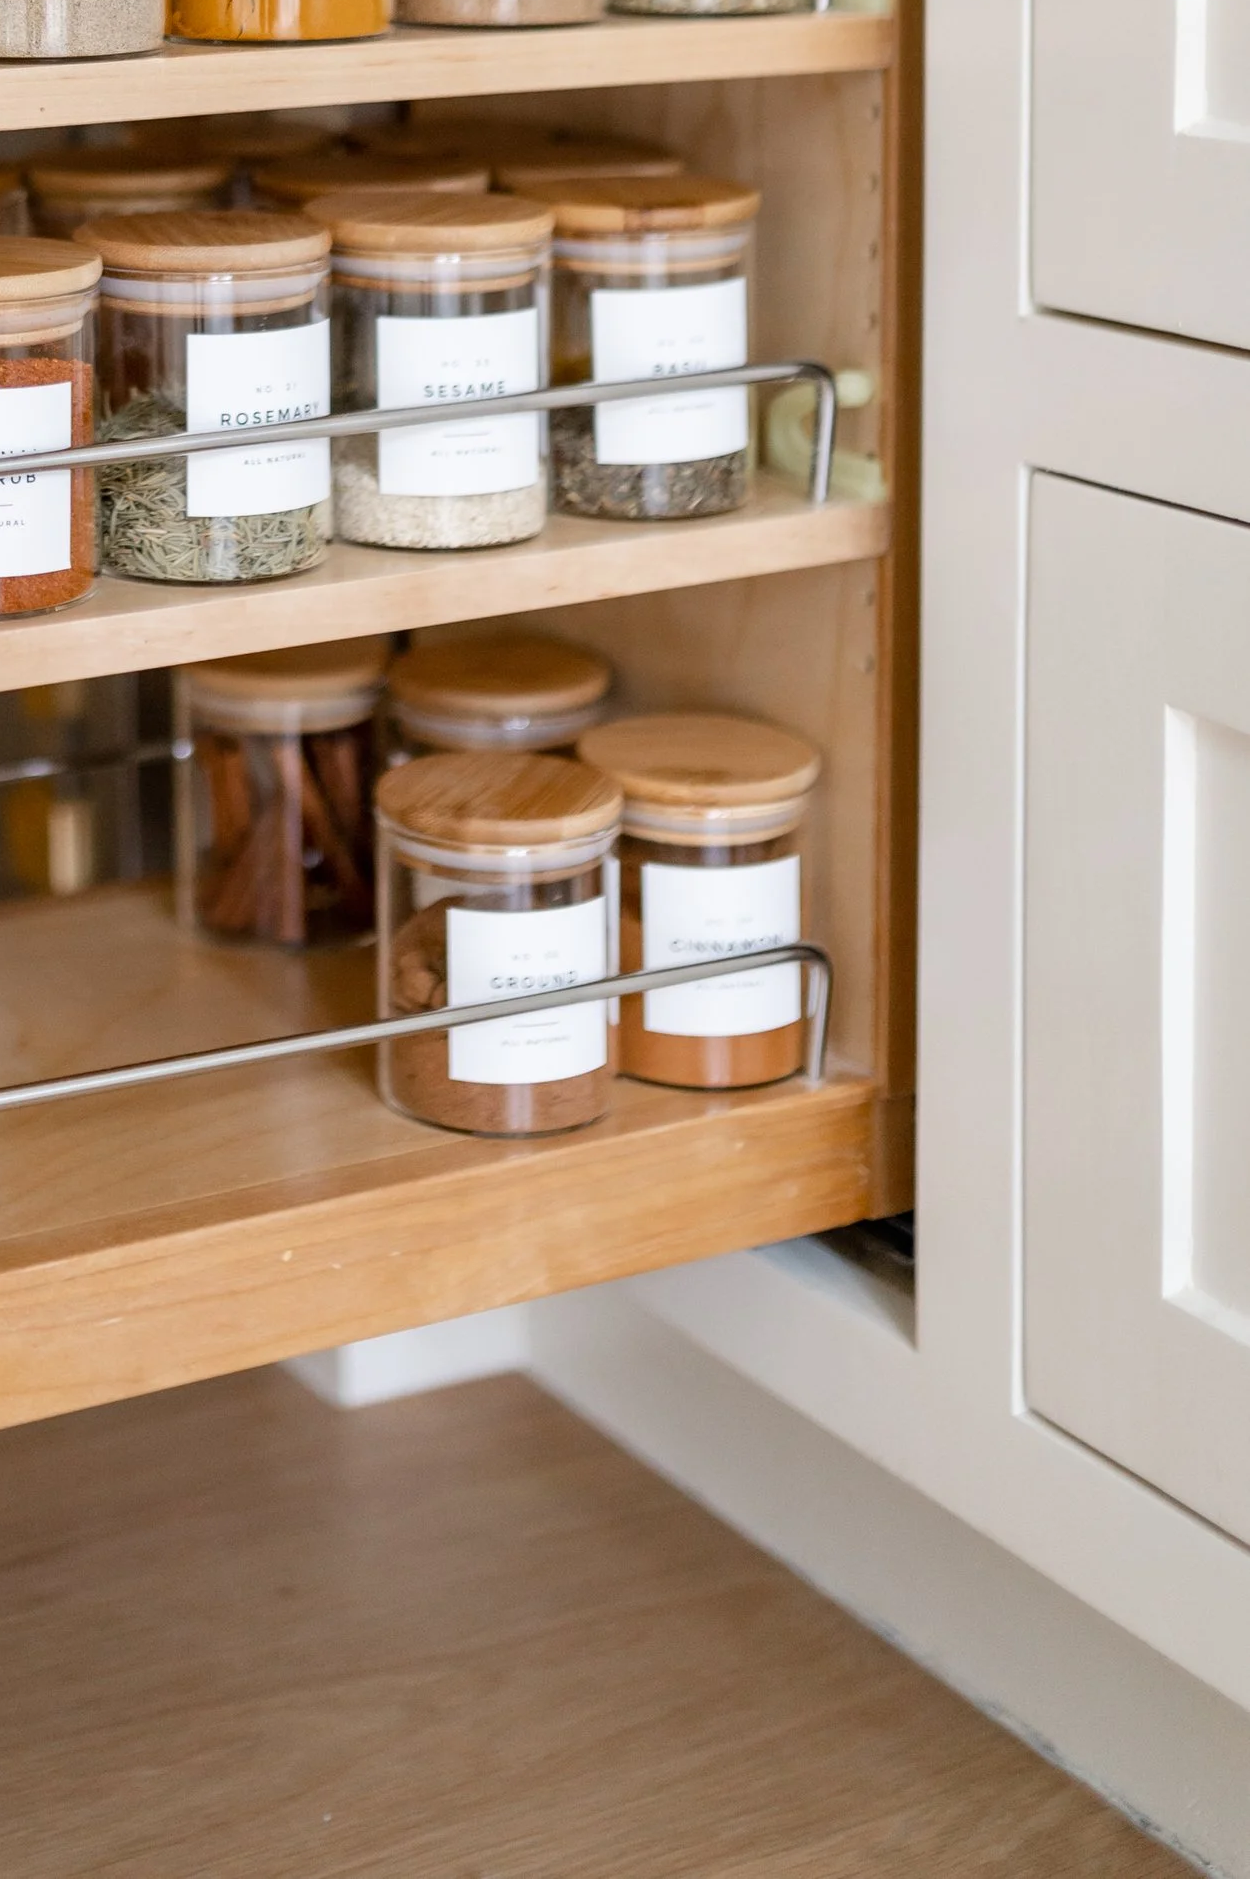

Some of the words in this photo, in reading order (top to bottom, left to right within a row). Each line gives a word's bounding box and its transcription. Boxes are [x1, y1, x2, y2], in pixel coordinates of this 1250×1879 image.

[423, 380, 505, 398] SESAME
[221, 401, 319, 426] ROSEMARY
[490, 970, 578, 989] GROUND
